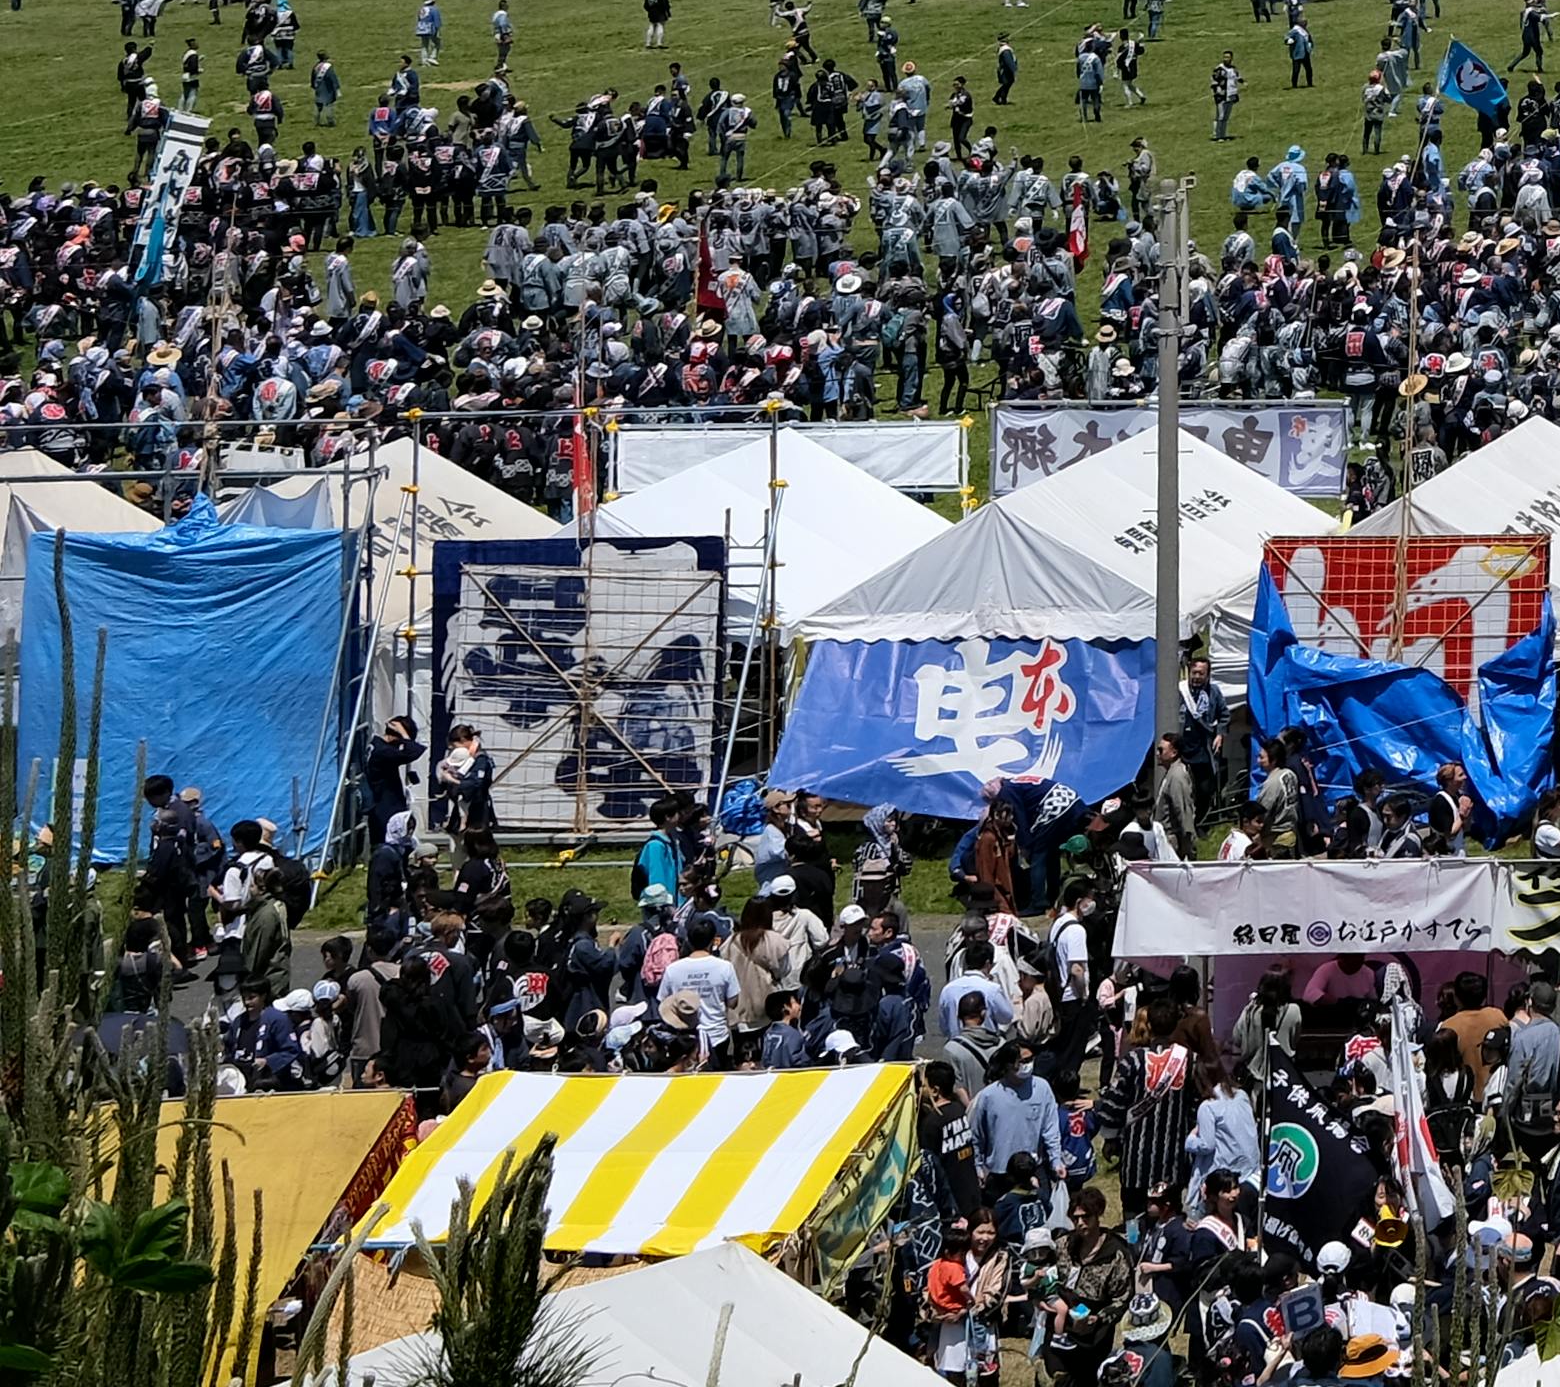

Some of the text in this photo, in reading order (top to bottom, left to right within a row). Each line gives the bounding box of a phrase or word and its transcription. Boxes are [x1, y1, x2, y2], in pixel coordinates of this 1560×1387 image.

[1337, 918, 1481, 944] お江戸かすてら
